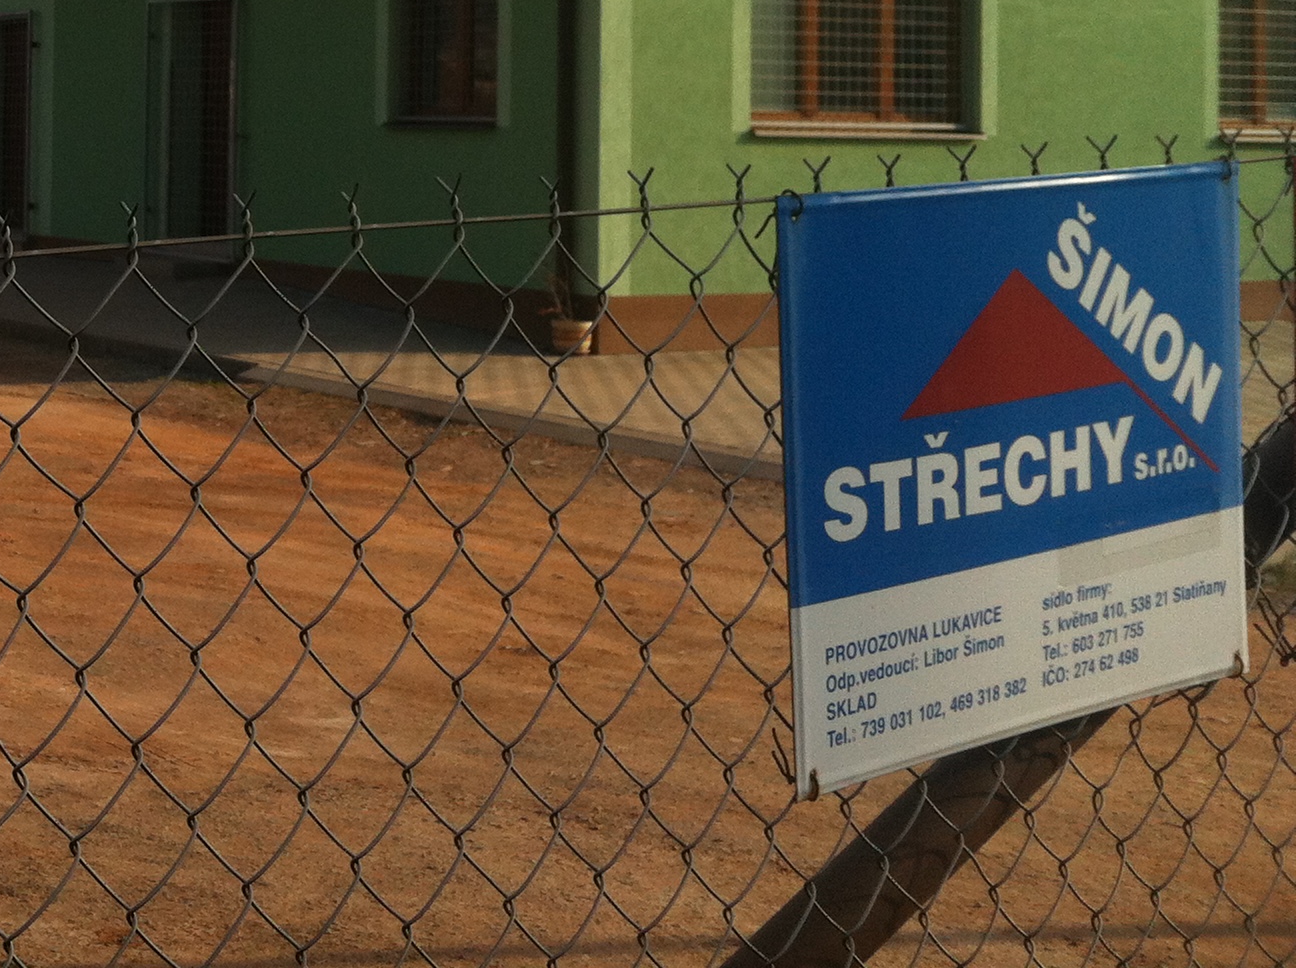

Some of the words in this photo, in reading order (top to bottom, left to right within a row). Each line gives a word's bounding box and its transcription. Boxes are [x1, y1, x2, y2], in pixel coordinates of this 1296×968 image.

[1046, 201, 1223, 424] ŠIMON
[823, 415, 1135, 543] STŘECHY
[1134, 444, 1196, 480] s.r.o.
[1057, 610, 1098, 633] května
[1131, 595, 1152, 614] 538
[1155, 591, 1168, 608] 21
[825, 625, 929, 666] PROVOZOVNA
[933, 605, 1002, 639] LUKAVICE
[924, 645, 959, 668] Libor
[963, 634, 1005, 657] Šimon
[1072, 634, 1094, 654] 603
[1098, 628, 1118, 647] 271
[1123, 621, 1144, 641] 755
[1042, 665, 1069, 687] IČO:
[1074, 660, 1095, 679] 274
[1099, 653, 1113, 672] 62
[1118, 647, 1139, 667] 498
[826, 692, 877, 720] SKLAD
[861, 717, 885, 739] 739
[890, 709, 913, 731] 031
[919, 701, 946, 722] 102,
[950, 692, 973, 712] 469
[977, 684, 1000, 705] 318
[1004, 677, 1027, 698] 382
